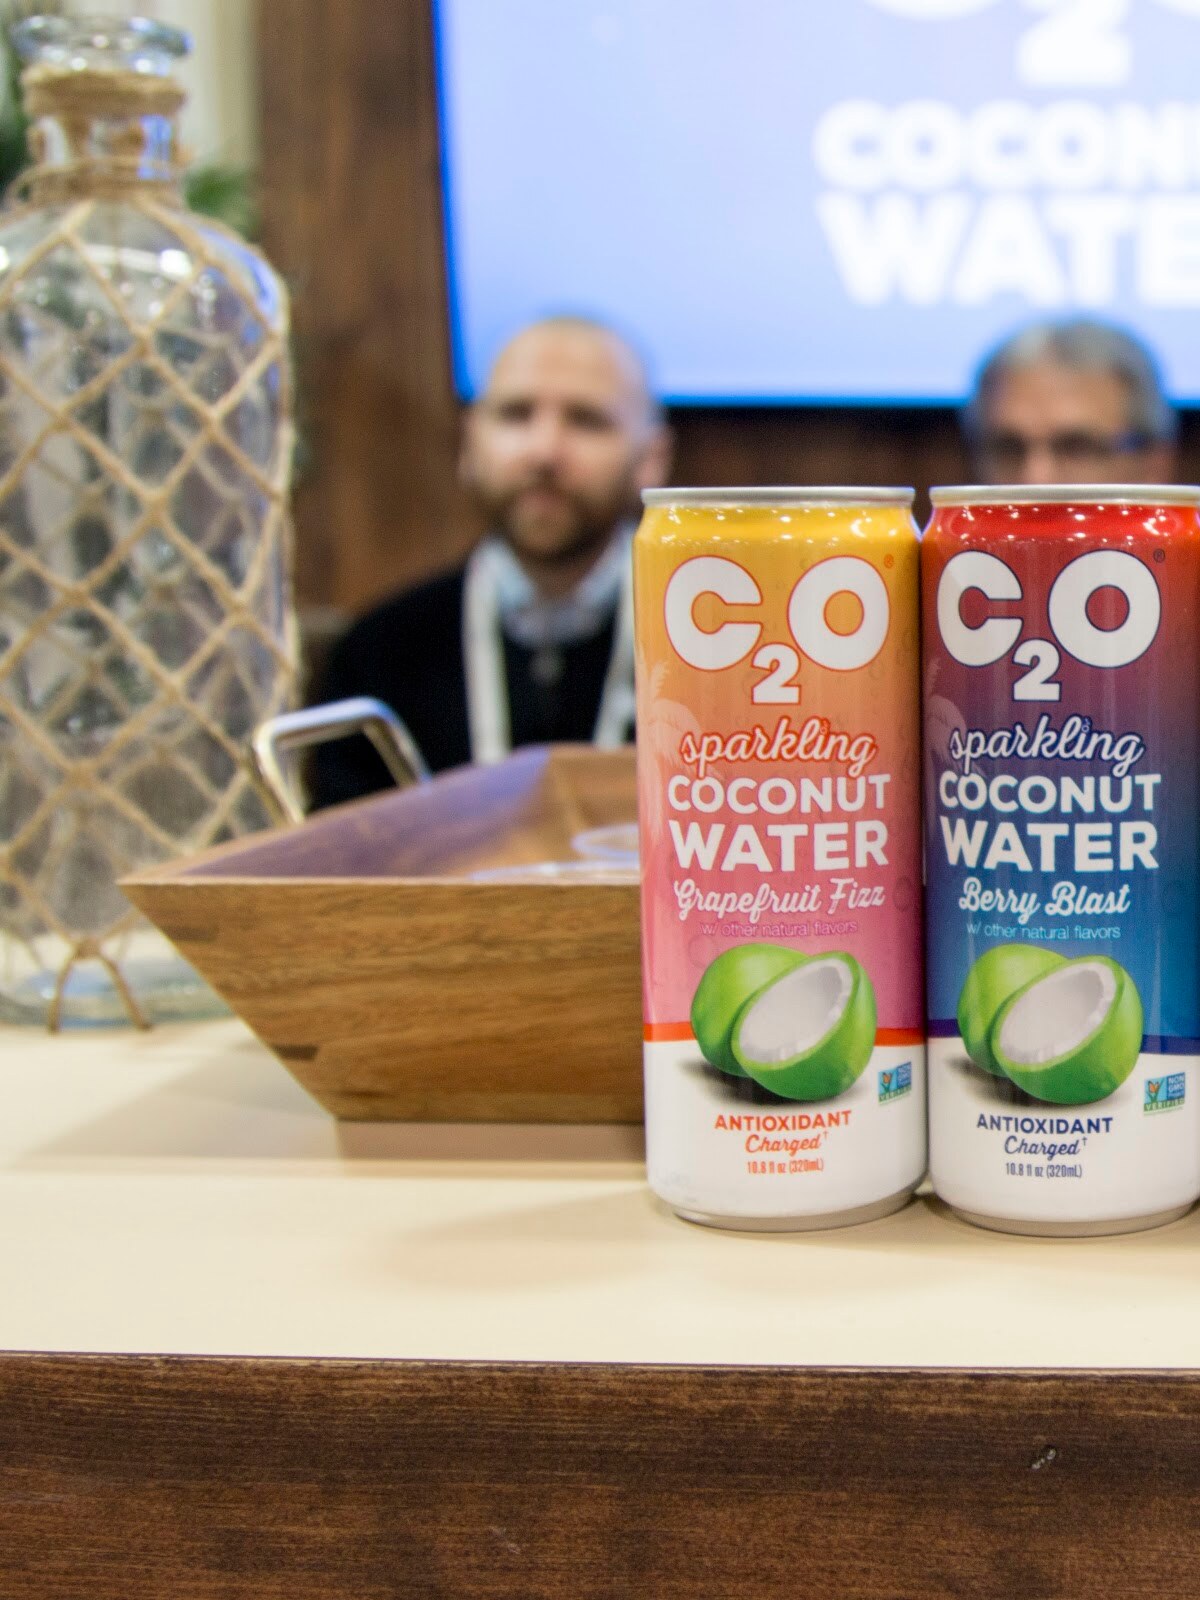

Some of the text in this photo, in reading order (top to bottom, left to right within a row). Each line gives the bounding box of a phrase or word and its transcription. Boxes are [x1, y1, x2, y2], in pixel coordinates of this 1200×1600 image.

[679, 715, 879, 778] sparkling
[948, 712, 1146, 778] sparkling
[667, 774, 891, 814] COCONUT
[938, 773, 1162, 813] COCONUT
[668, 819, 889, 872] WATER
[939, 815, 1160, 872] WATER
[673, 878, 886, 924] Grapefruit Fizz
[958, 877, 1131, 925] Berry Blast
[722, 922, 758, 936] other
[763, 922, 809, 936] natural
[814, 920, 857, 935] flavors
[984, 923, 1017, 937] other
[1021, 924, 1069, 939] natural
[1074, 924, 1121, 939] flavors
[714, 1110, 852, 1132] ANTIOXIDANT
[977, 1113, 1113, 1135] ANTIOXIDANT
[747, 1160, 767, 1174] 10.8
[1006, 1162, 1024, 1176] 10.8
